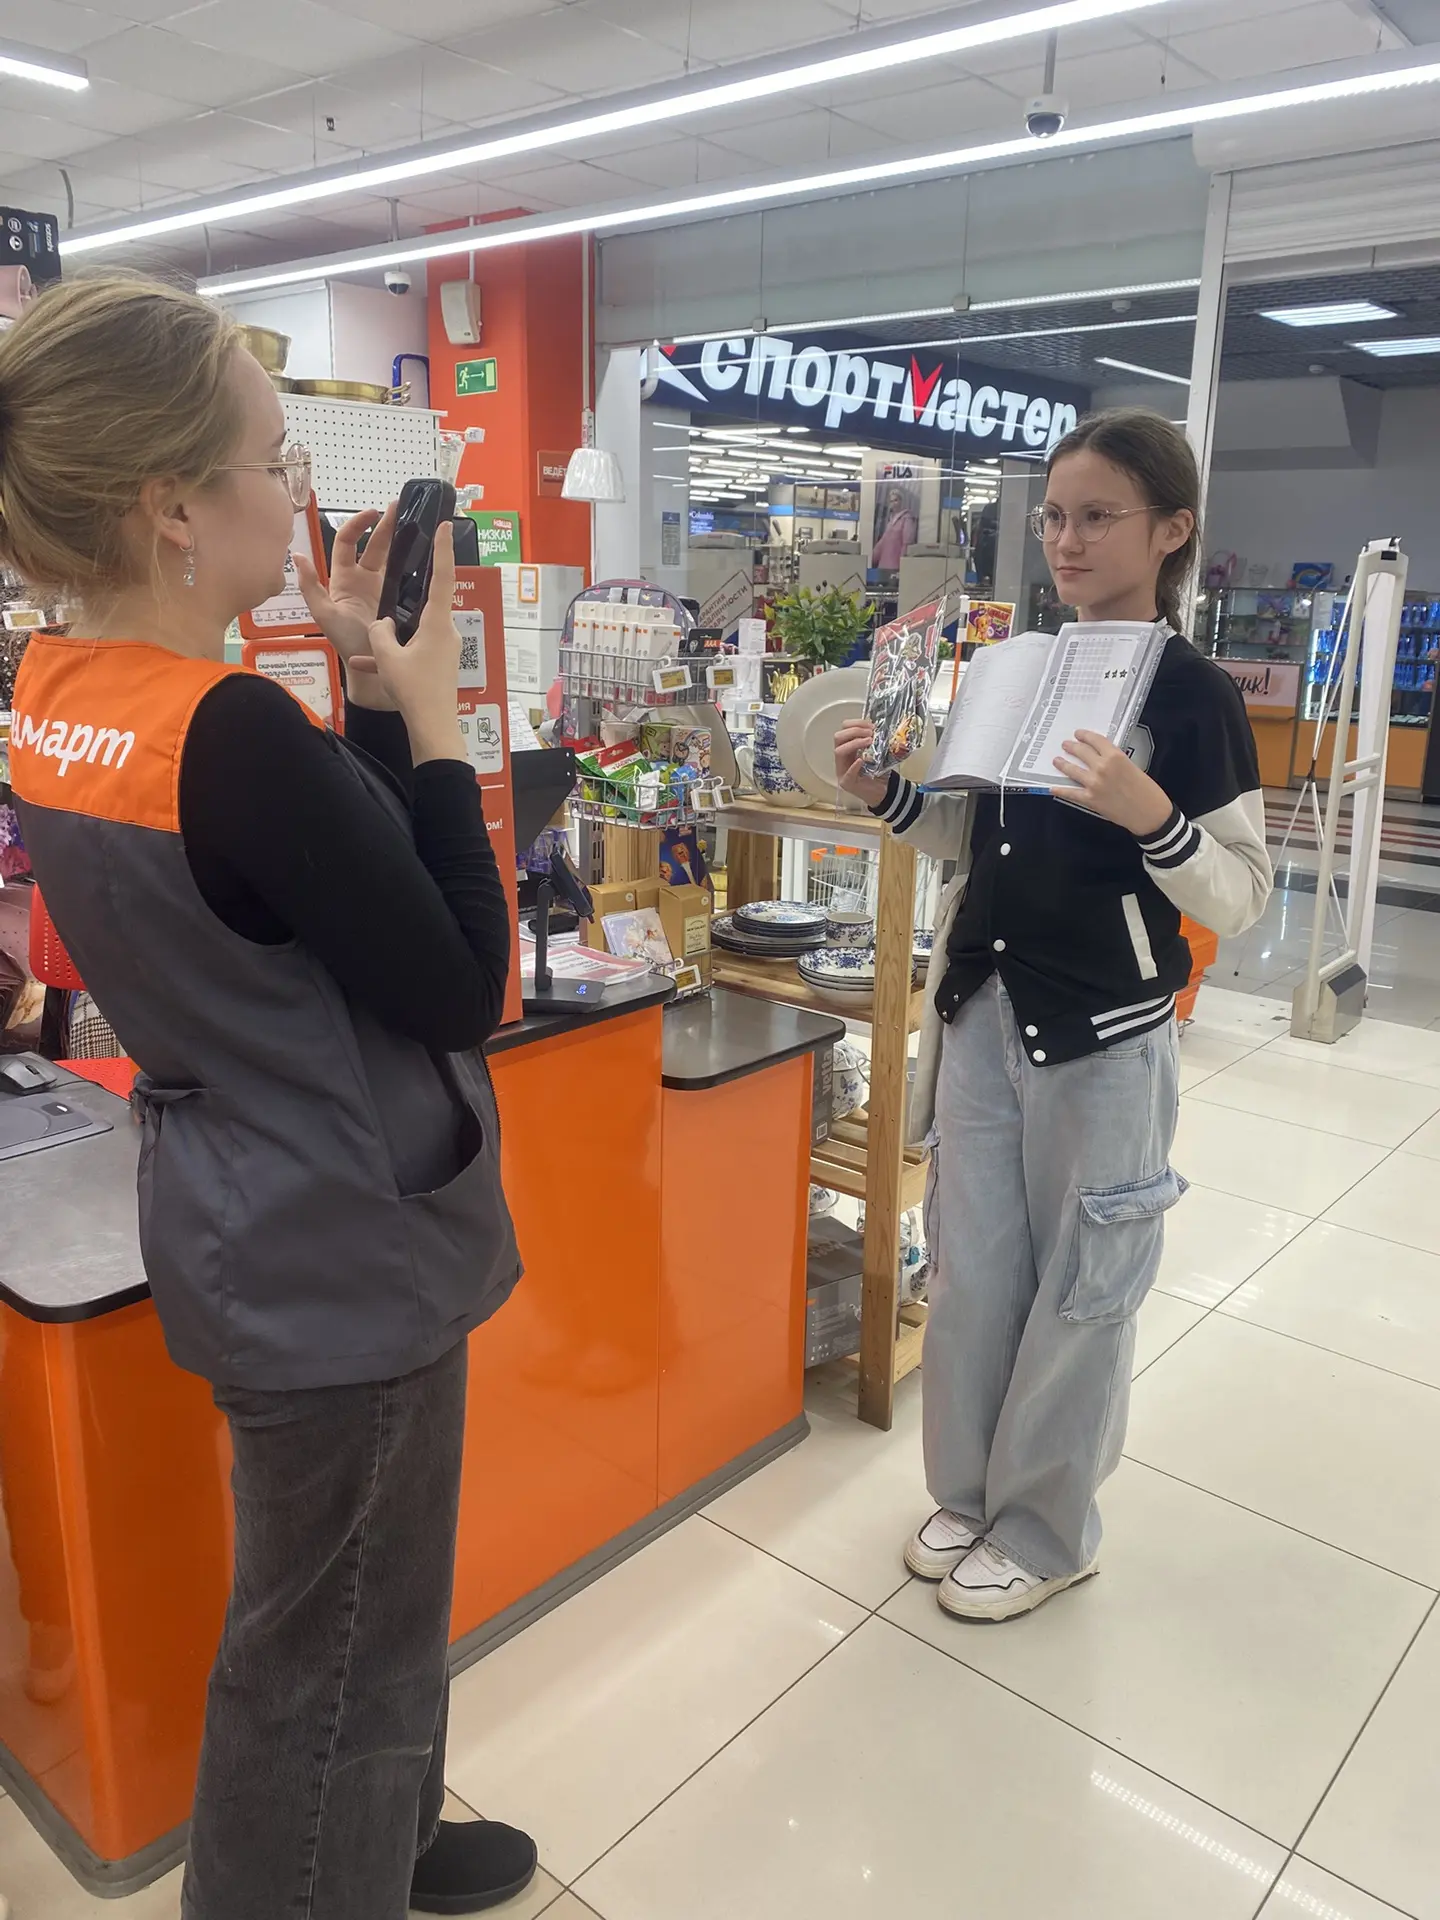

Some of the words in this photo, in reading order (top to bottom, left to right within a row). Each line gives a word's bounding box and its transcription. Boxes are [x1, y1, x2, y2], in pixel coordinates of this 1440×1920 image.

[884, 465, 912, 479] FILA
[478, 529, 512, 540] НИЗКАЯ
[821, 1049, 832, 1096] vetta
